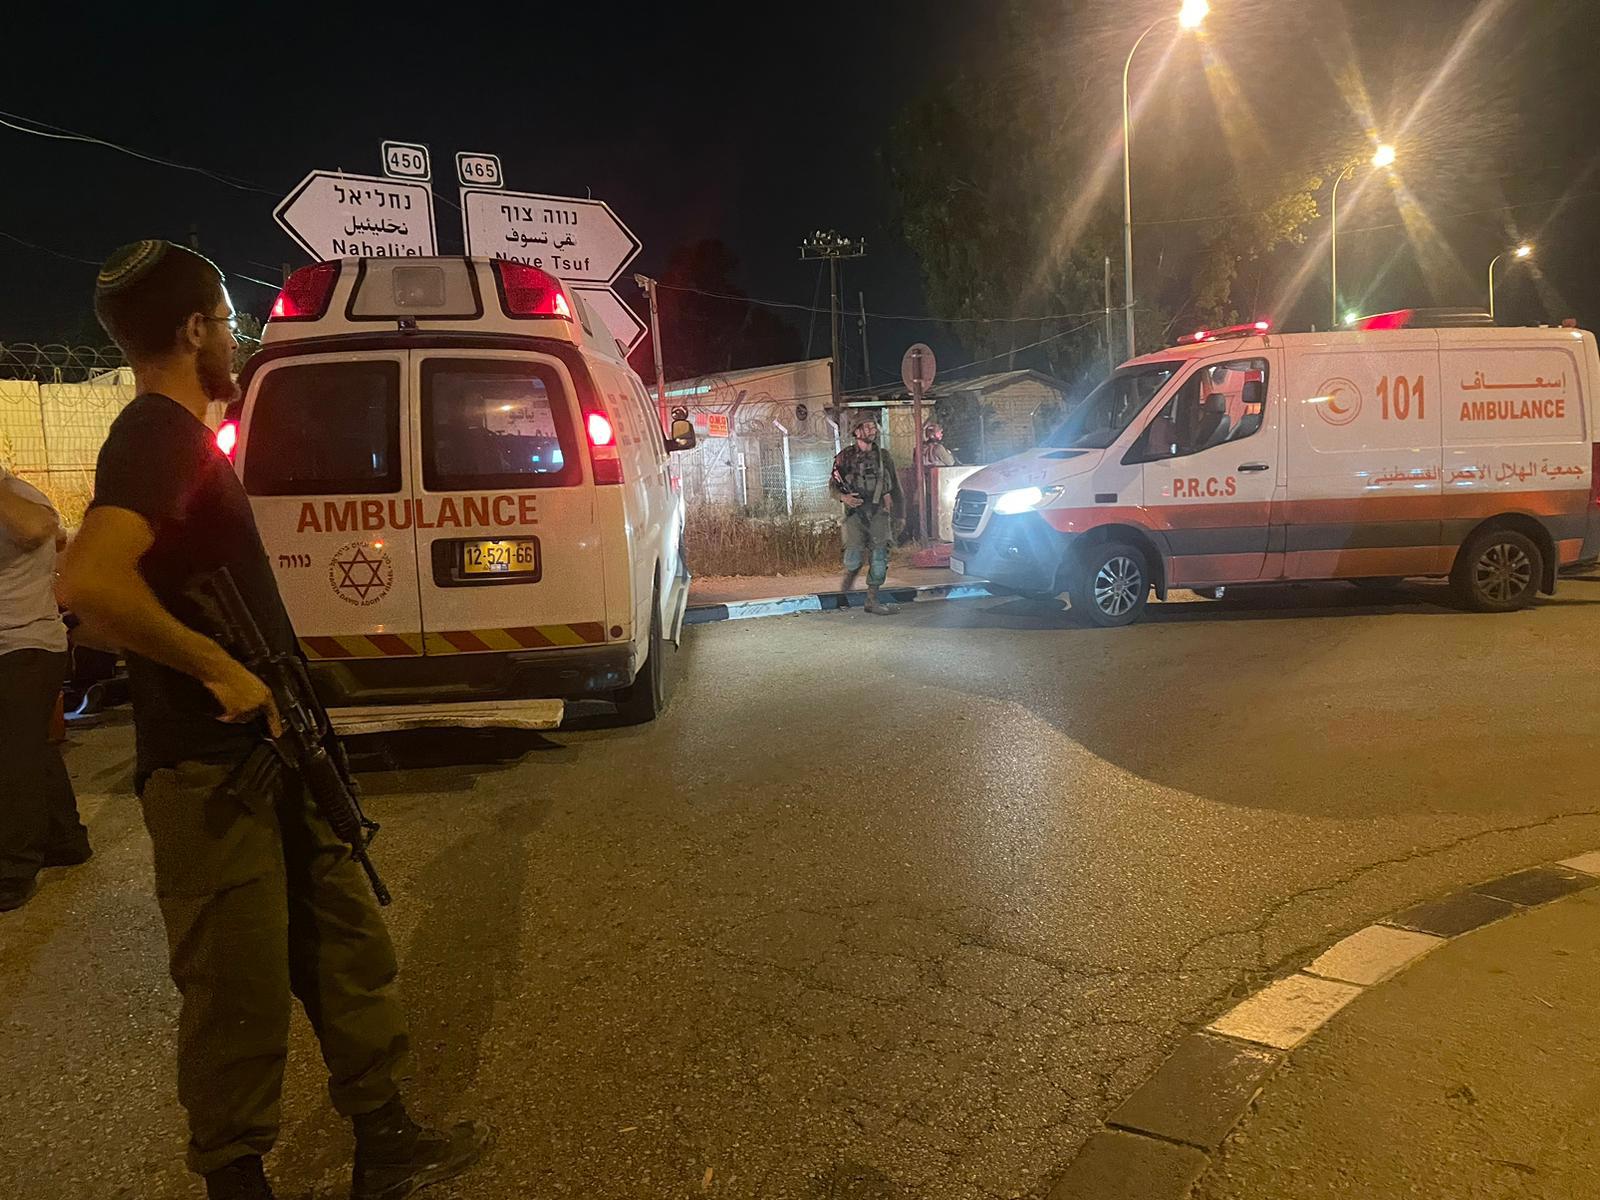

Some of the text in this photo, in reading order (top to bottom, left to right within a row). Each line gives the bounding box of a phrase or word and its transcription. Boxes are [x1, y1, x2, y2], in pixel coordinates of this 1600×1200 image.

[391, 152, 422, 170] 450
[465, 163, 494, 178] 465
[334, 185, 411, 210] נחליאל
[501, 205, 577, 225] נווה צוף
[505, 228, 549, 247] تسوف
[332, 239, 423, 257] Nahali'el
[551, 256, 590, 271] Tsuf
[1376, 375, 1425, 420] 101
[1460, 400, 1565, 421] AMBULANCE
[1496, 462, 1537, 482] الهلال
[1541, 458, 1584, 480] جمعية
[1173, 476, 1237, 498] P.R.C.S
[297, 494, 539, 533] AMBULANCE
[279, 554, 311, 568] נווה
